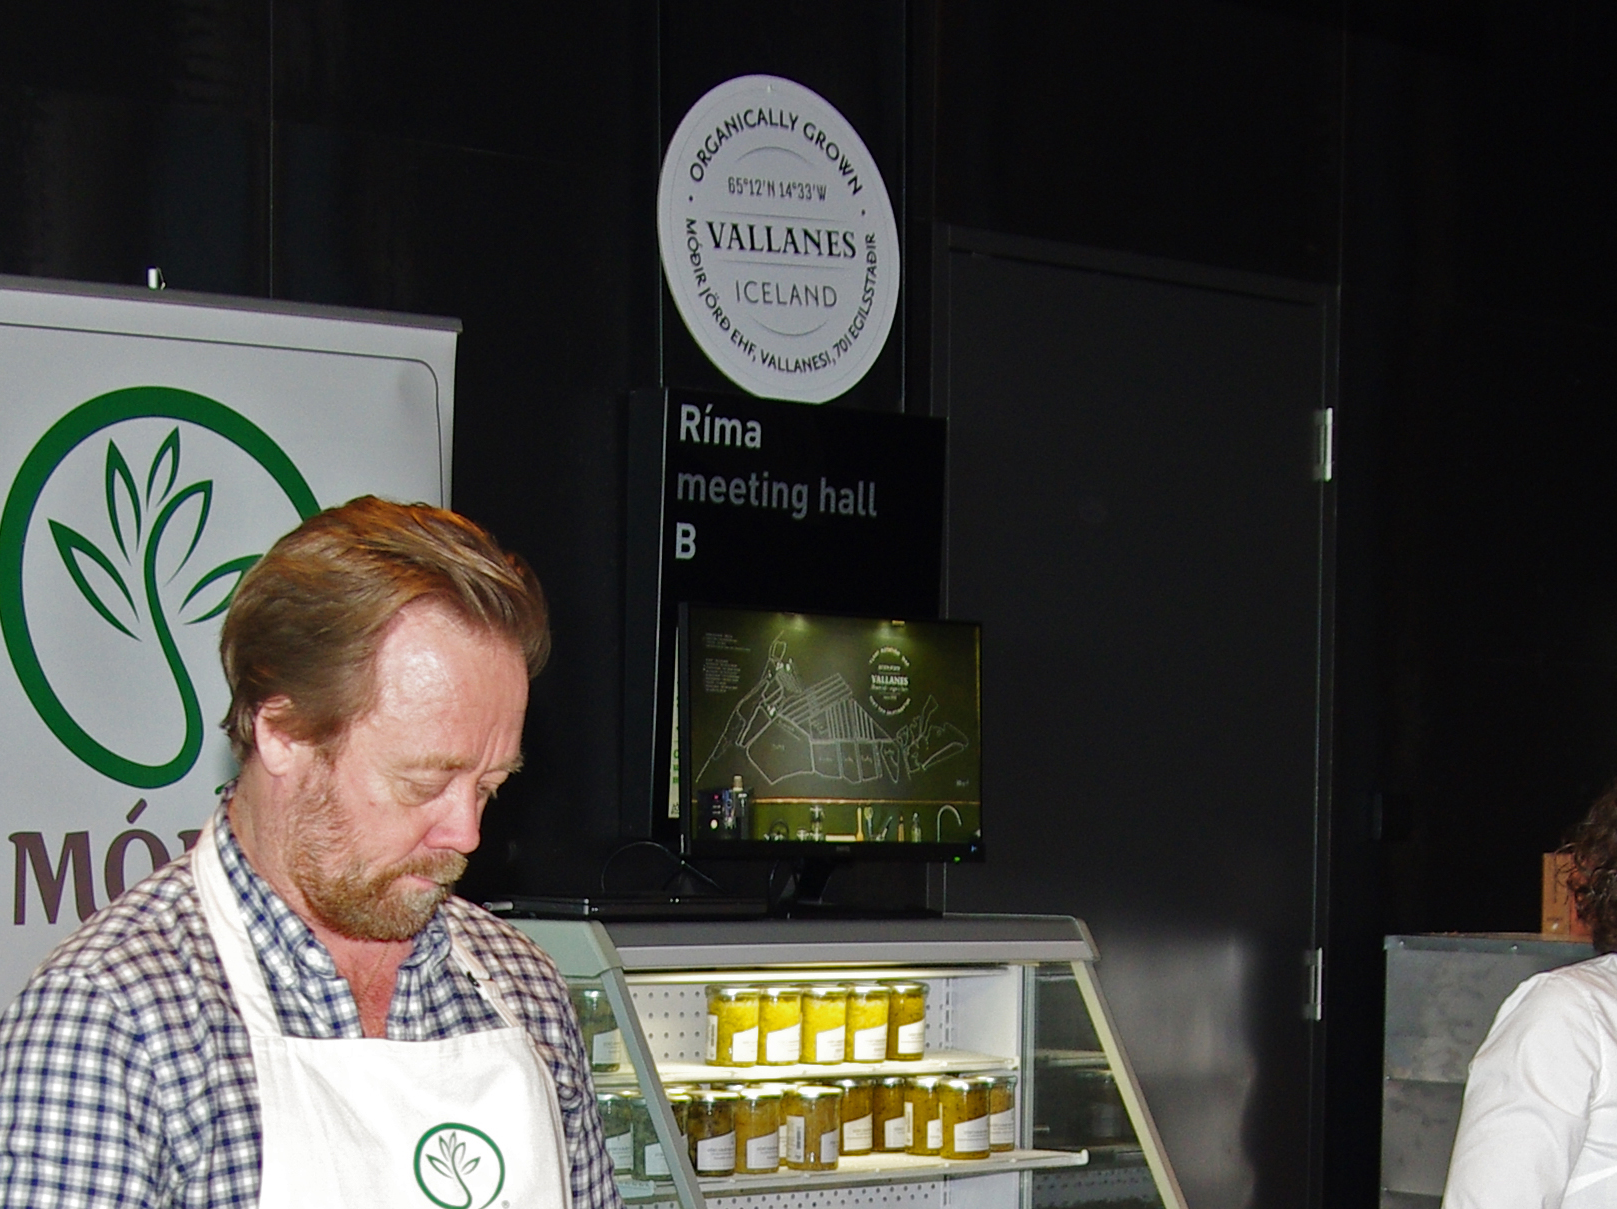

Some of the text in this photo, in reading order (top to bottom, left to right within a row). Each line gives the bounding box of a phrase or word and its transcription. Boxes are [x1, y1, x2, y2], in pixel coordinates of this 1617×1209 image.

[689, 106, 863, 197] ORGANICALLY GROWN
[706, 221, 858, 259] VALLANES
[735, 279, 838, 308] ICELAND
[760, 347, 836, 373] VALLANESI,
[679, 403, 763, 448] Ríma
[677, 470, 878, 520] meeting hall
[675, 521, 698, 559] B
[8, 797, 206, 927] MÓ
